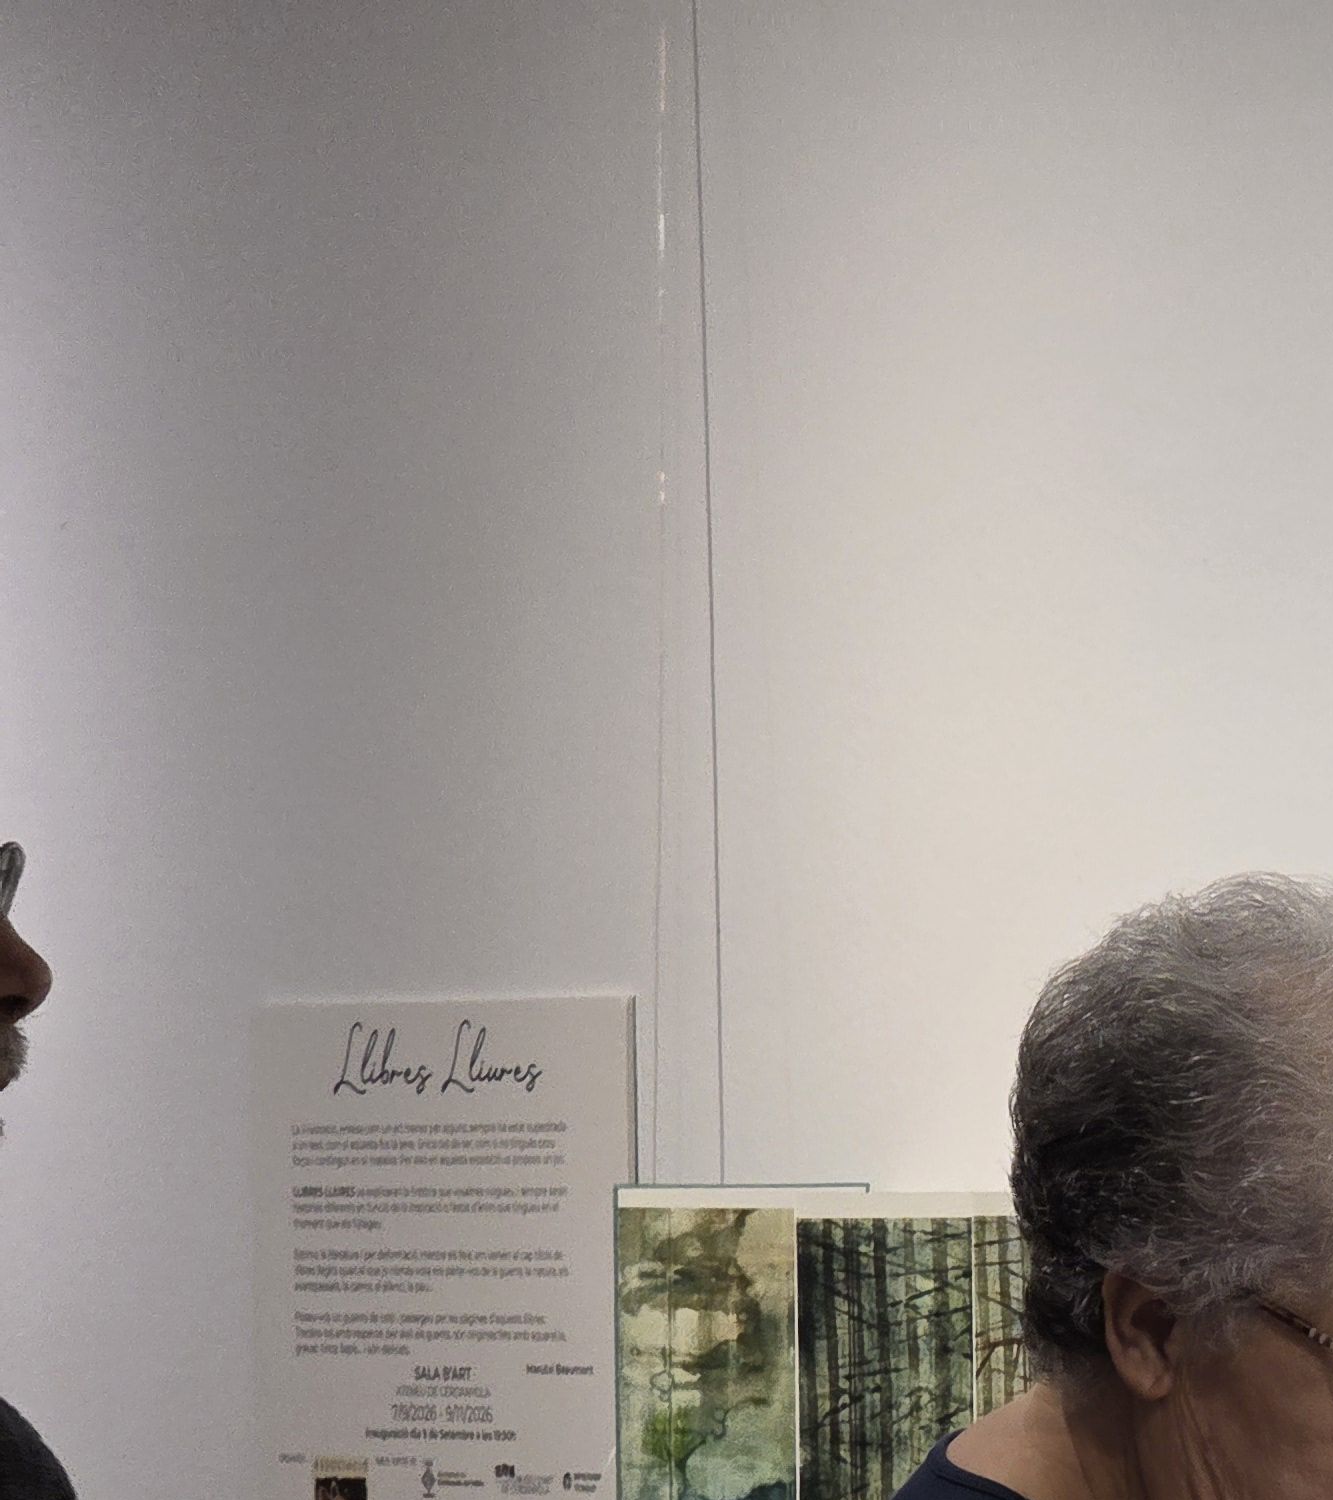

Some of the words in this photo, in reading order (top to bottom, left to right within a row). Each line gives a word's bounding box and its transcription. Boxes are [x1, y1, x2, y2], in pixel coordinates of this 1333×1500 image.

[334, 1021, 432, 1095] Llibres
[441, 1019, 542, 1094] Lliures
[414, 1365, 441, 1381] SALA
